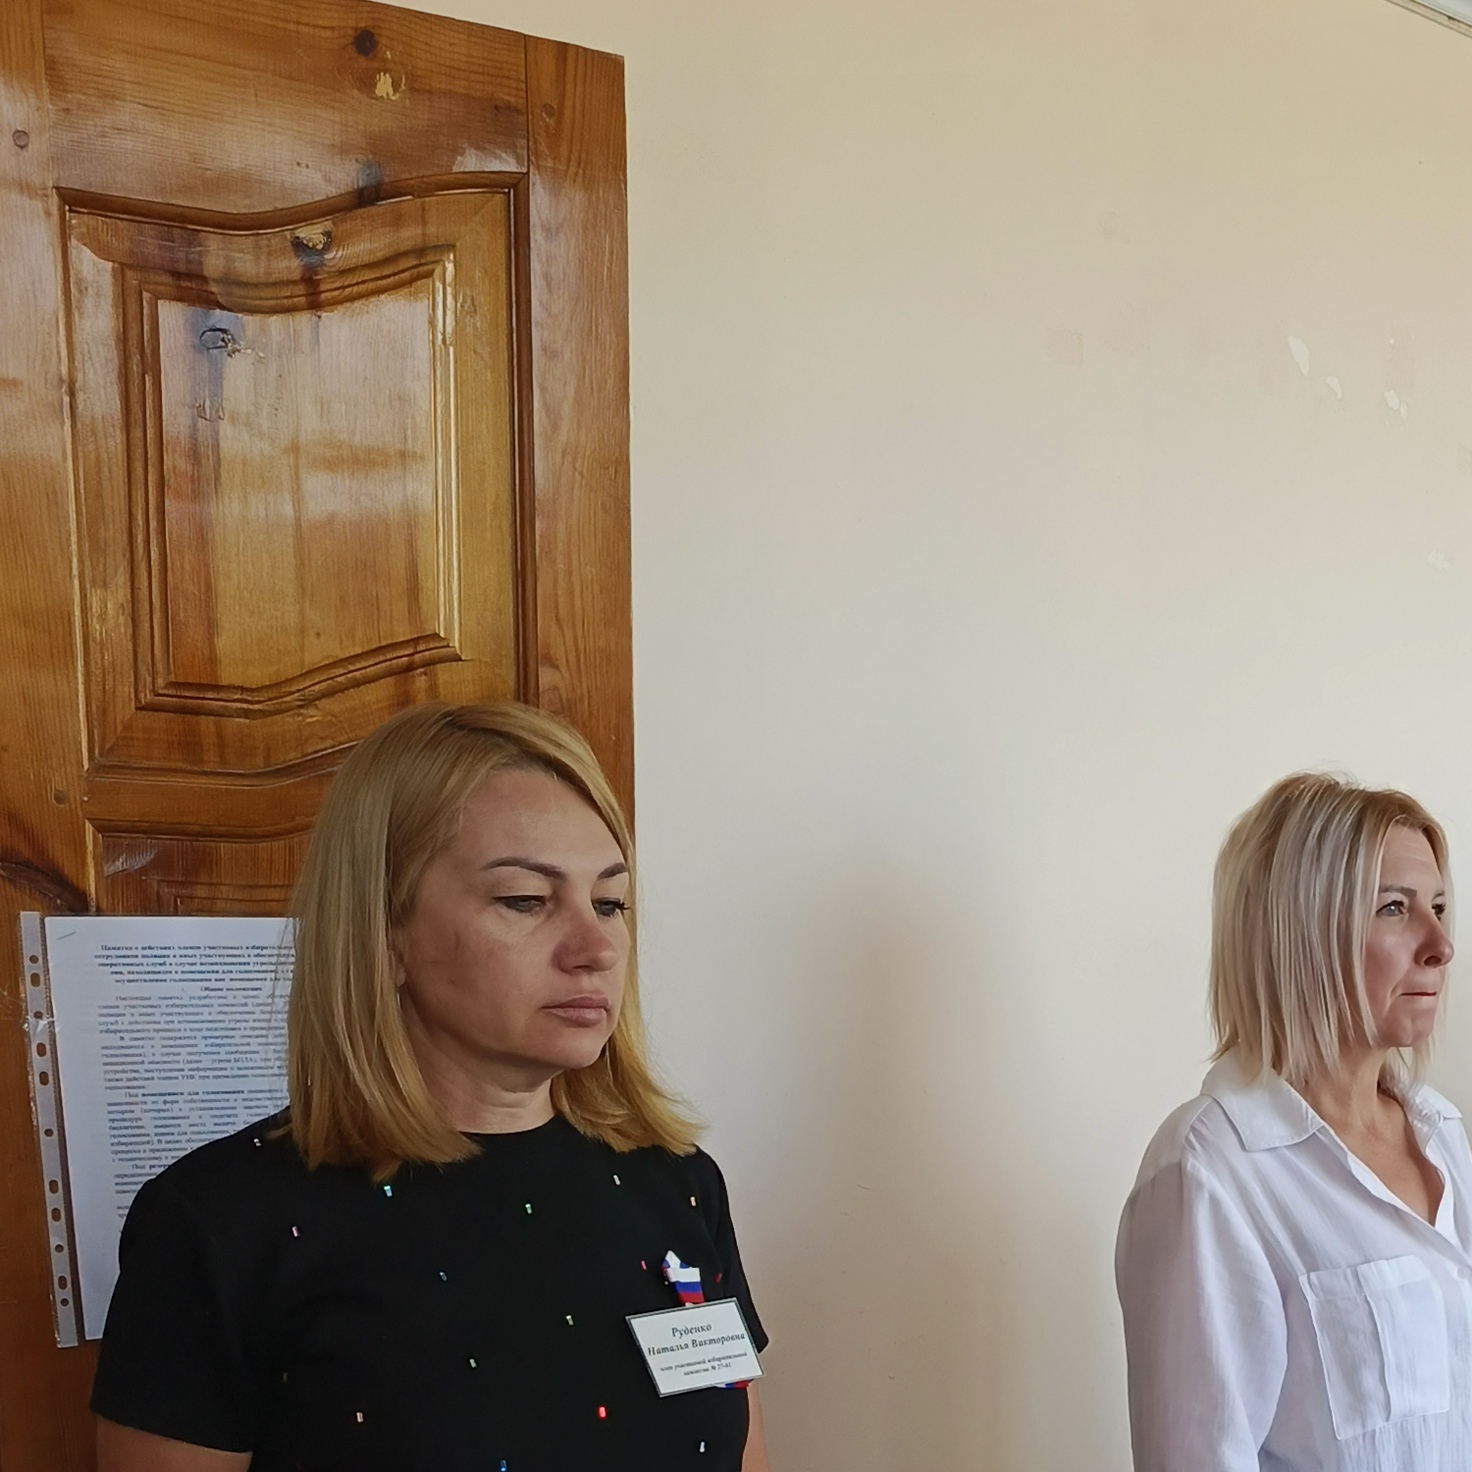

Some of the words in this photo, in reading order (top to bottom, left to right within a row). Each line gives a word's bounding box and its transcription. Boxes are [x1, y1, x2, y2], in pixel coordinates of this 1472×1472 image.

[671, 1324, 712, 1338] Руденко
[648, 1342, 689, 1356] Наталья
[691, 1333, 745, 1349] Викторовна
